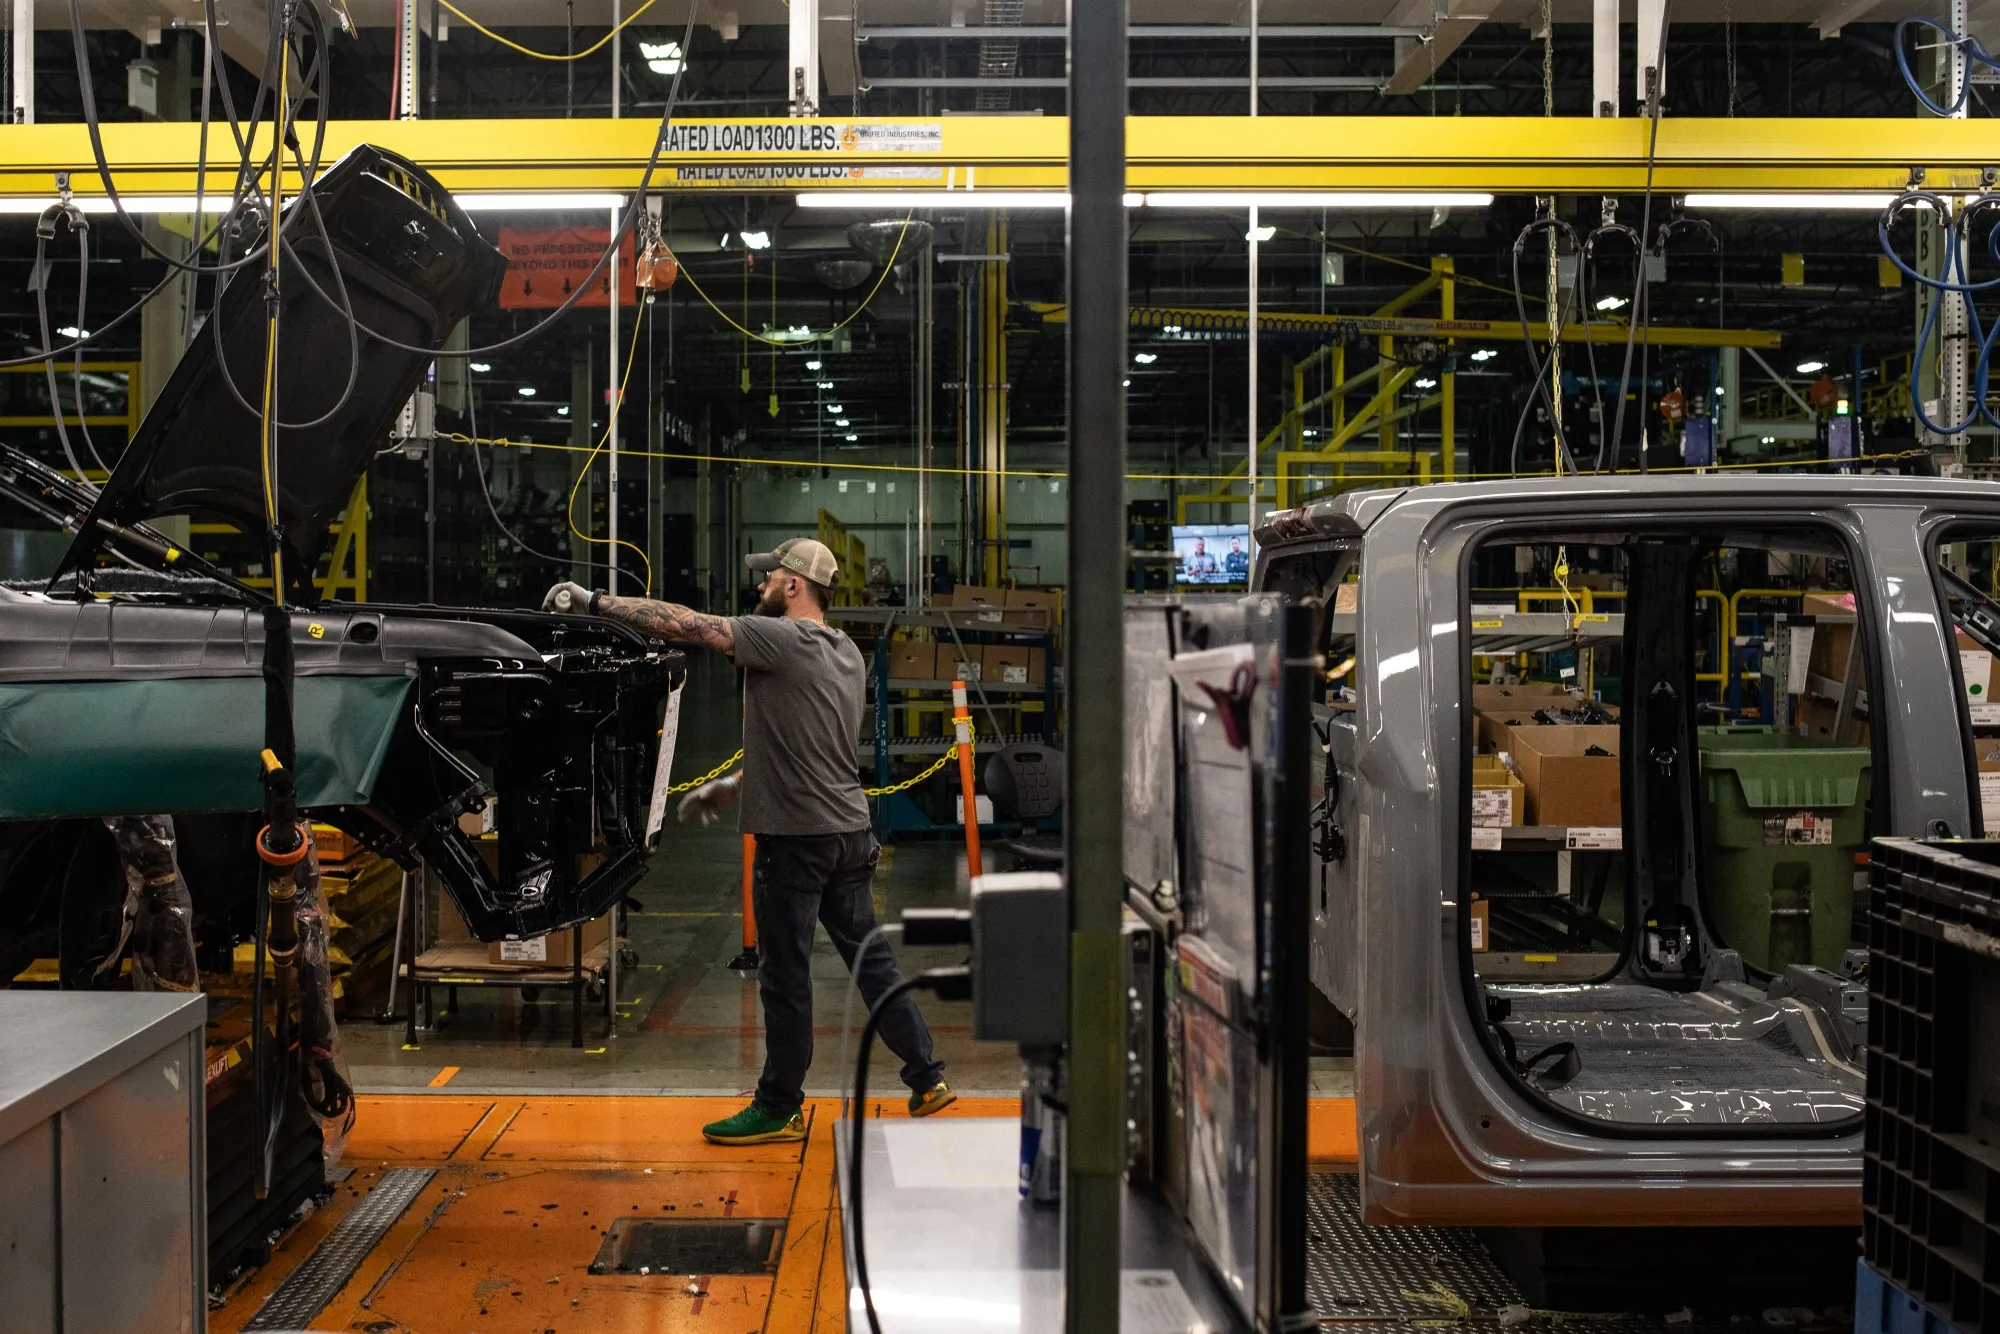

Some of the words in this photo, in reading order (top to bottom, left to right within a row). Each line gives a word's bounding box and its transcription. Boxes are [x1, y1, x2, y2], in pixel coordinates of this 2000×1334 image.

[800, 125, 840, 151] LBS.
[887, 131, 927, 139] INDUSTRIES,
[512, 245, 530, 254] NO
[311, 626, 322, 635] R
